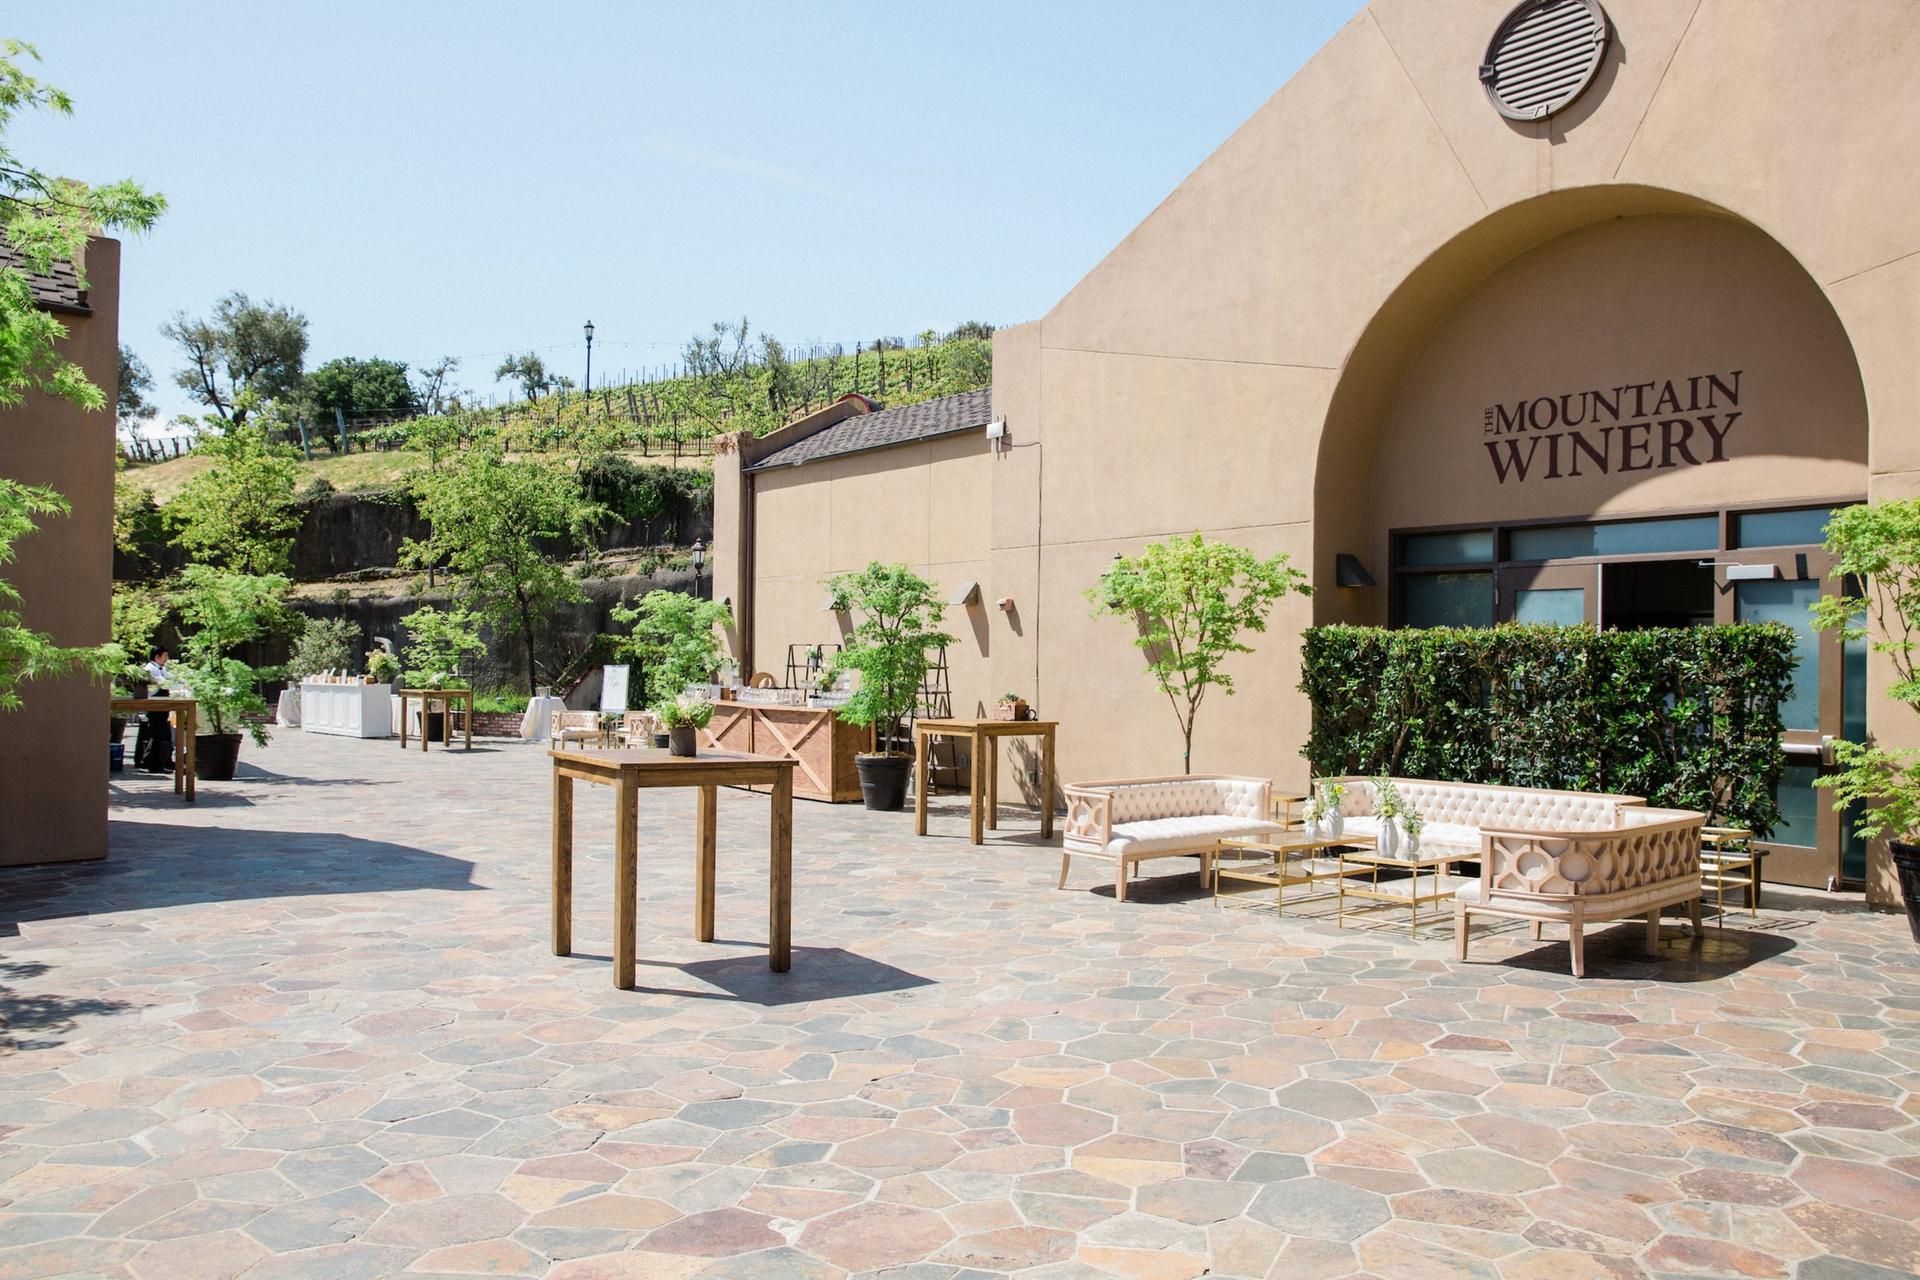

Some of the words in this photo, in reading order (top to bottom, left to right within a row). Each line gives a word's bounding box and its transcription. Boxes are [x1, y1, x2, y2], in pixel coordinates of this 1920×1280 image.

[1484, 406, 1494, 436] THE
[1494, 370, 1743, 435] MOUNTAIN
[1483, 412, 1742, 485] WINERY
